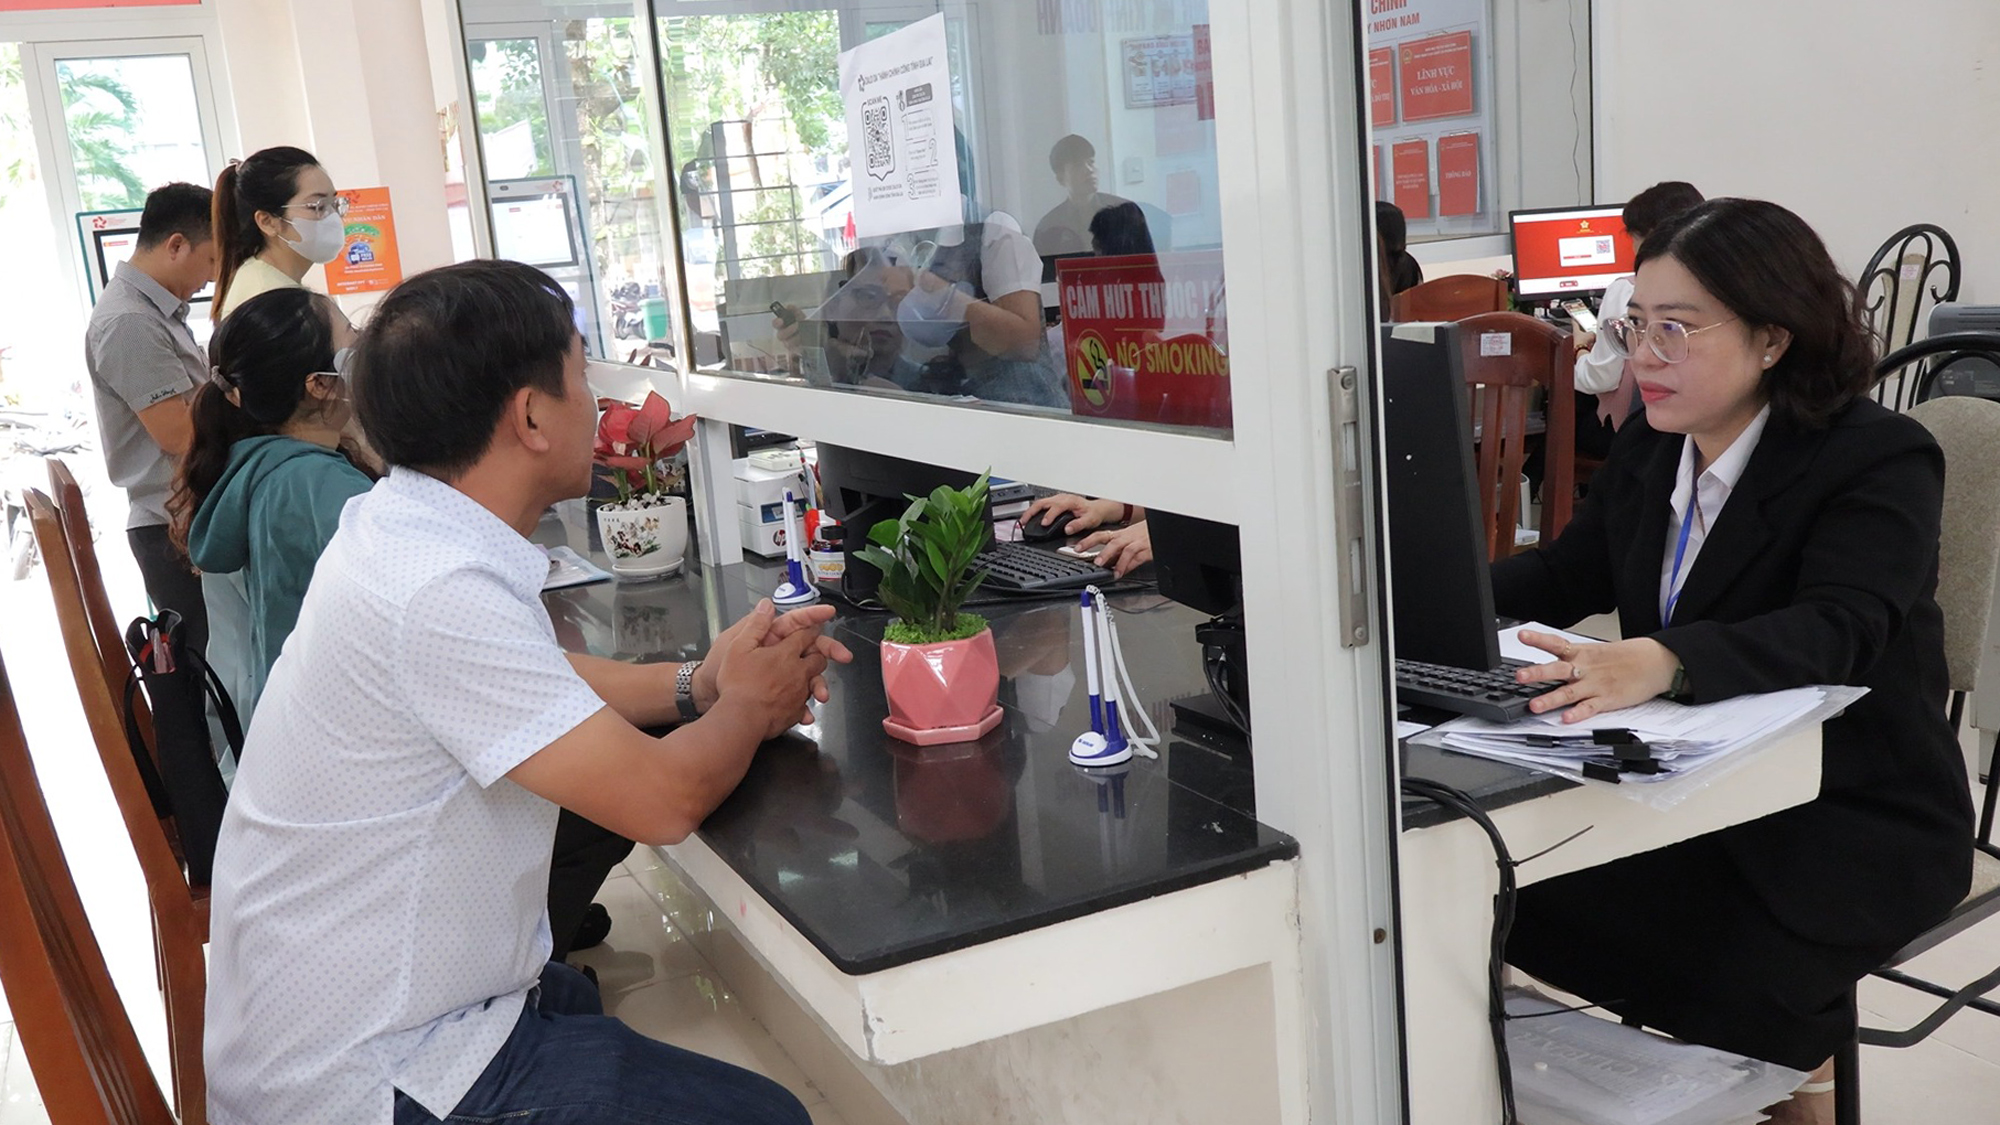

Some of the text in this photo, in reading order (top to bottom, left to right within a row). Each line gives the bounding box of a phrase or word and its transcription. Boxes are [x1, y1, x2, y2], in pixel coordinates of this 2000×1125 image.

[1373, 16, 1398, 33] NHƠN
[1400, 12, 1420, 28] NAM
[1065, 274, 1100, 320] CẤM
[1103, 278, 1135, 319] HÚT
[1138, 275, 1199, 320] THUỐC
[1116, 341, 1229, 377] NO SMOKING
